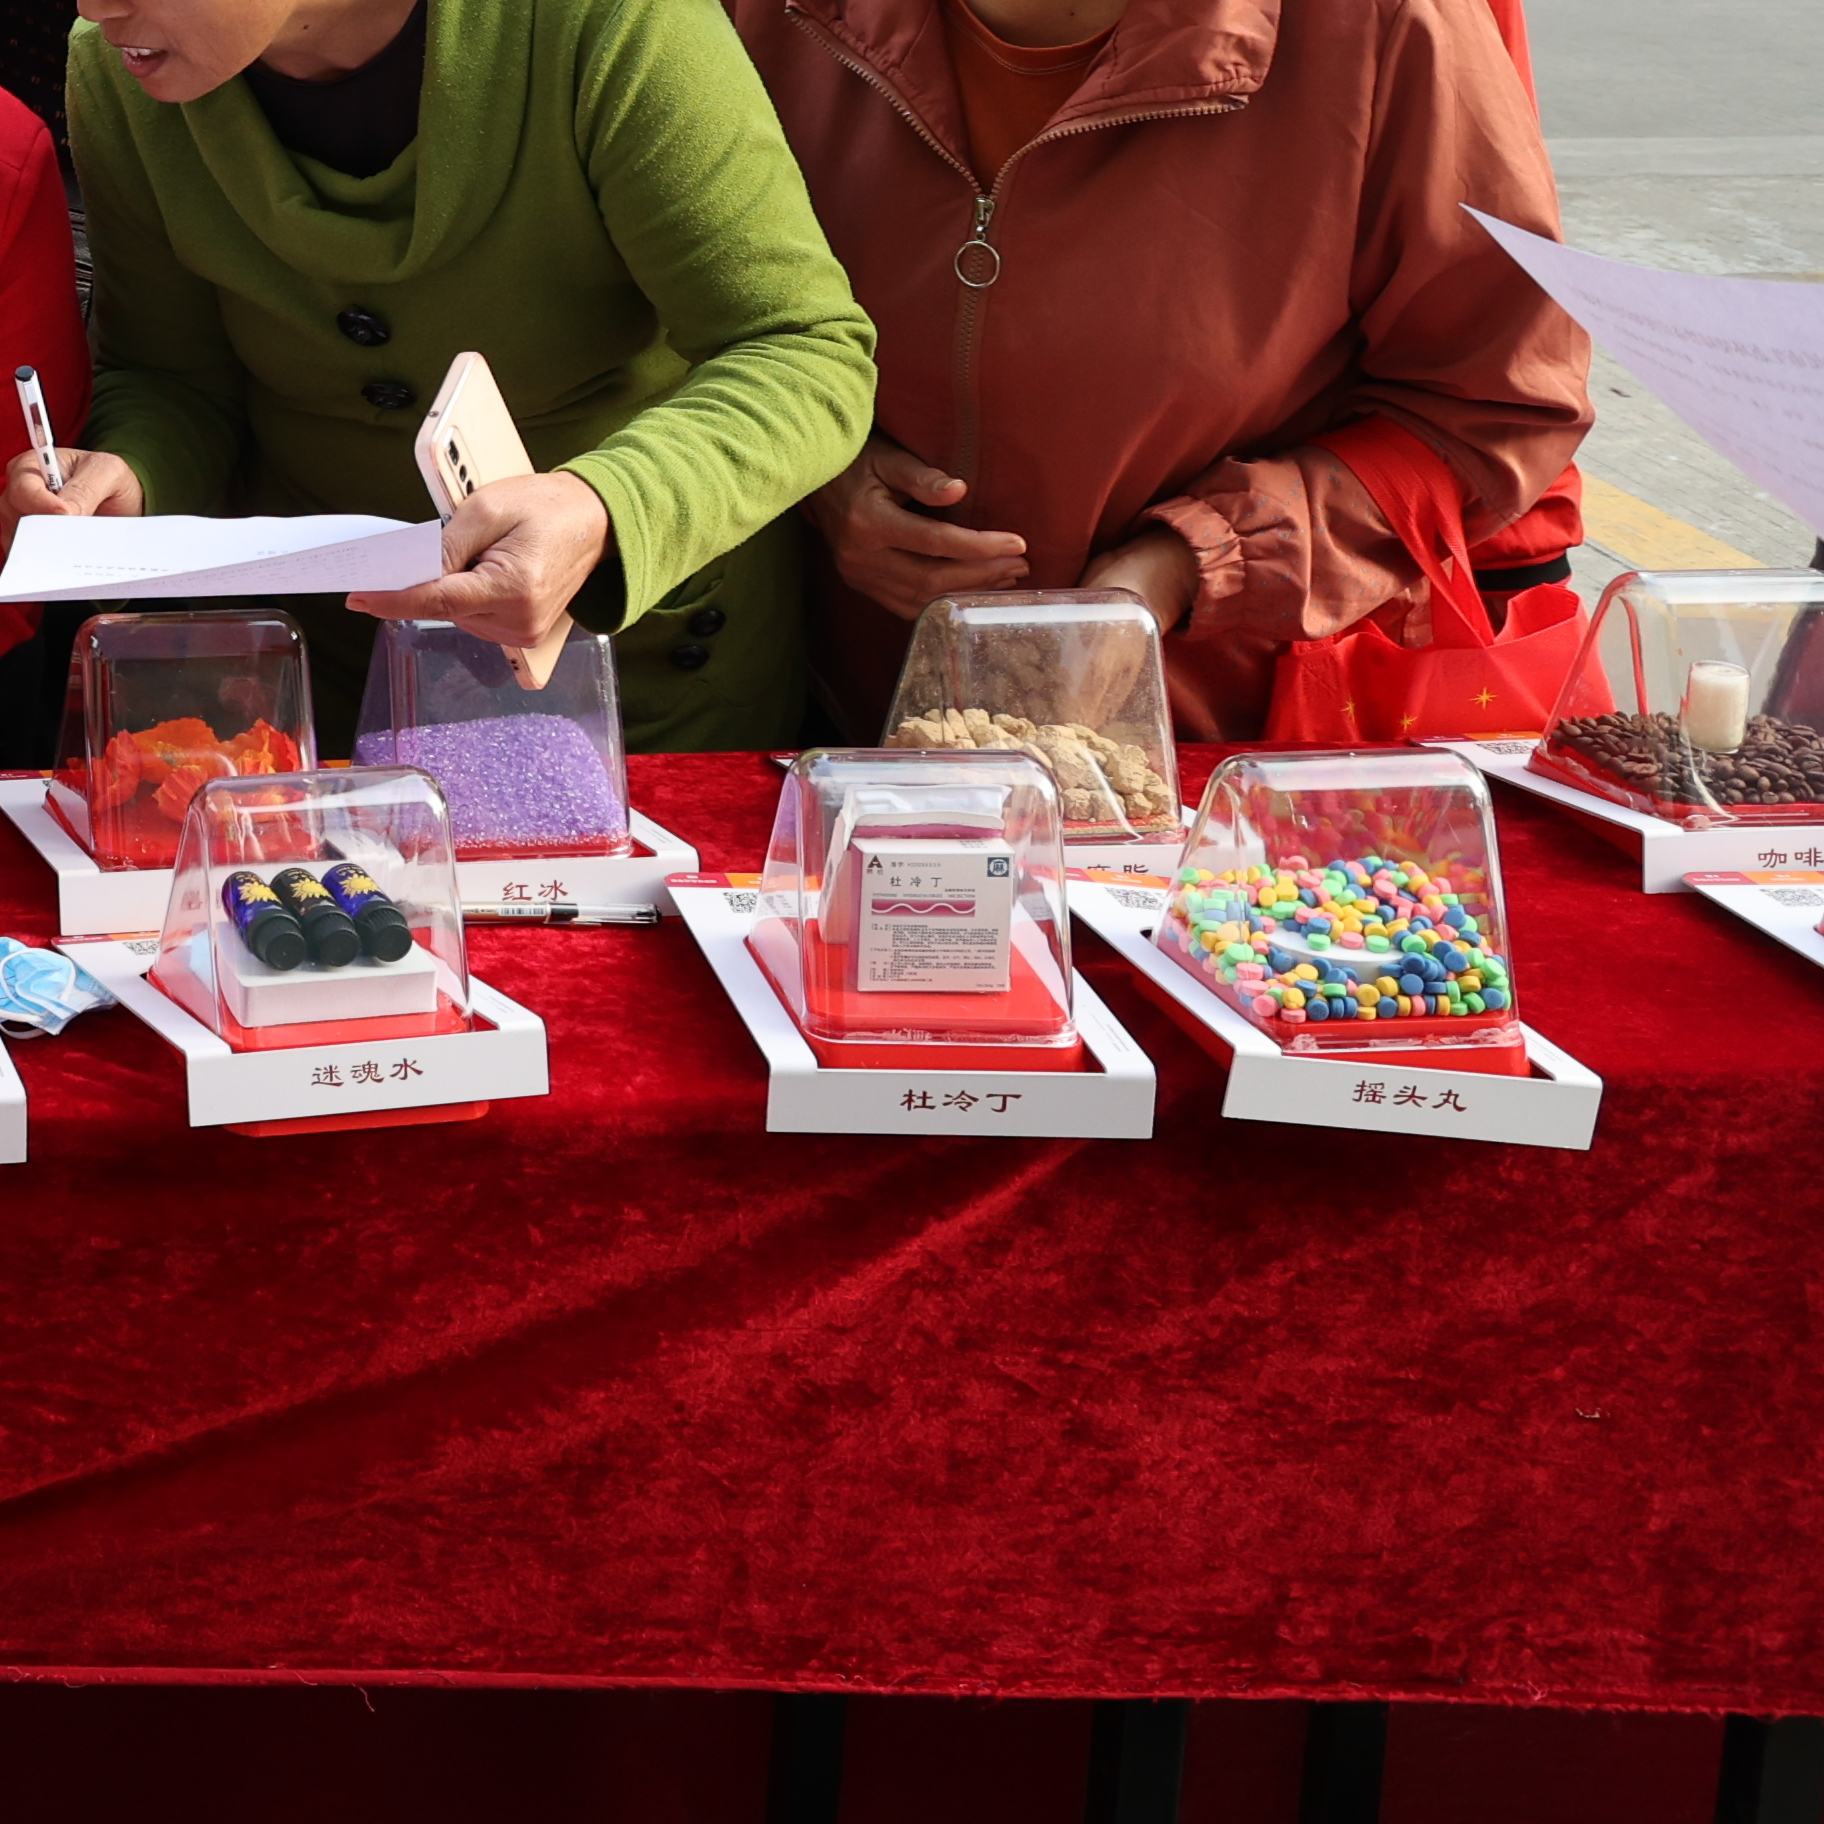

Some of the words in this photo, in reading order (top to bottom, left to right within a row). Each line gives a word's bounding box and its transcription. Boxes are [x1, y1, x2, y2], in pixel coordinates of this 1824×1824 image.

[502, 879, 569, 903] 红冰
[890, 876, 942, 887] 杜冷丁
[309, 1056, 425, 1090] 迷魂水
[900, 1087, 1023, 1115] 杜冷丁
[1351, 1079, 1470, 1114] 摇头丸
